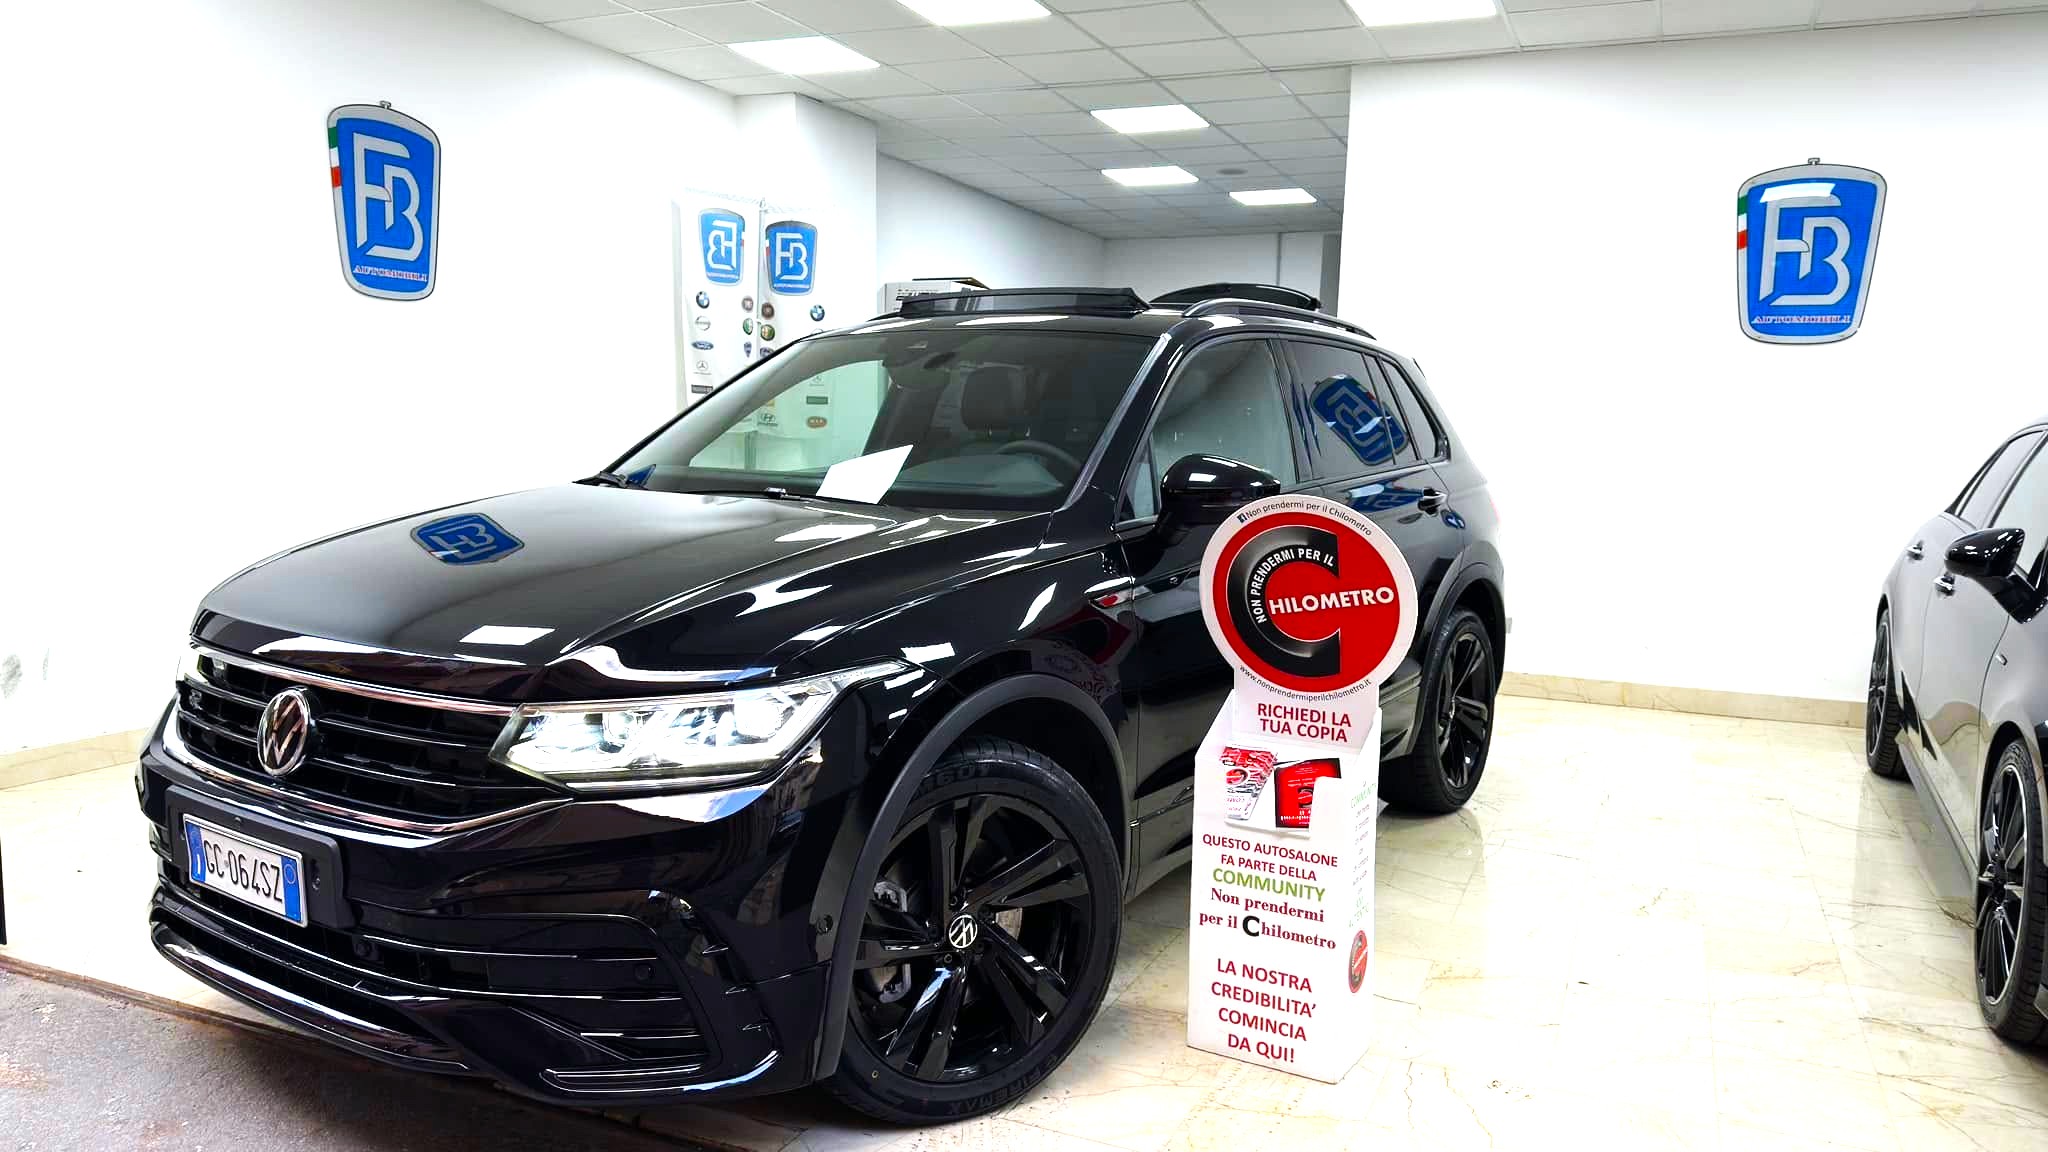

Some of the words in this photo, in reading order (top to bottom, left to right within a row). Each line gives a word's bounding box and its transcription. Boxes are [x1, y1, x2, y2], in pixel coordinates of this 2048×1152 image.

[1246, 507, 1262, 519] Non
[1263, 501, 1304, 513] prendermi
[1306, 502, 1321, 513] per
[1322, 504, 1328, 512] il
[1329, 507, 1372, 536] Chilometro
[1298, 548, 1321, 561] PER
[1323, 553, 1335, 567] IL
[1251, 548, 1295, 596] PRENDERMI
[1251, 598, 1267, 624] NON
[1257, 703, 1327, 725] RICHIEDI
[1332, 711, 1352, 728] LA
[1260, 718, 1292, 735] TUA
[1297, 724, 1348, 743] COPIA
[1202, 834, 1251, 852] QUESTO
[1254, 843, 1338, 867] AUTOSALONE
[1221, 854, 1235, 866] FA
[1238, 857, 1275, 874] PARTE
[1279, 864, 1317, 881] DELLA
[1213, 868, 1325, 902] COMMUNITY
[1211, 887, 1240, 905] Non
[1244, 896, 1325, 922] prendermi
[1199, 912, 1224, 926] per
[1227, 915, 1237, 929] il
[1242, 915, 1336, 949] Chilometro
[1217, 958, 1237, 976] LA
[1242, 963, 1312, 993] NOSTRA
[1211, 981, 1316, 1018] CREDIBILITA'
[1218, 1007, 1307, 1041] COMINCIA
[1227, 1033, 1251, 1052] DA
[1256, 1041, 1295, 1063] QUI!
